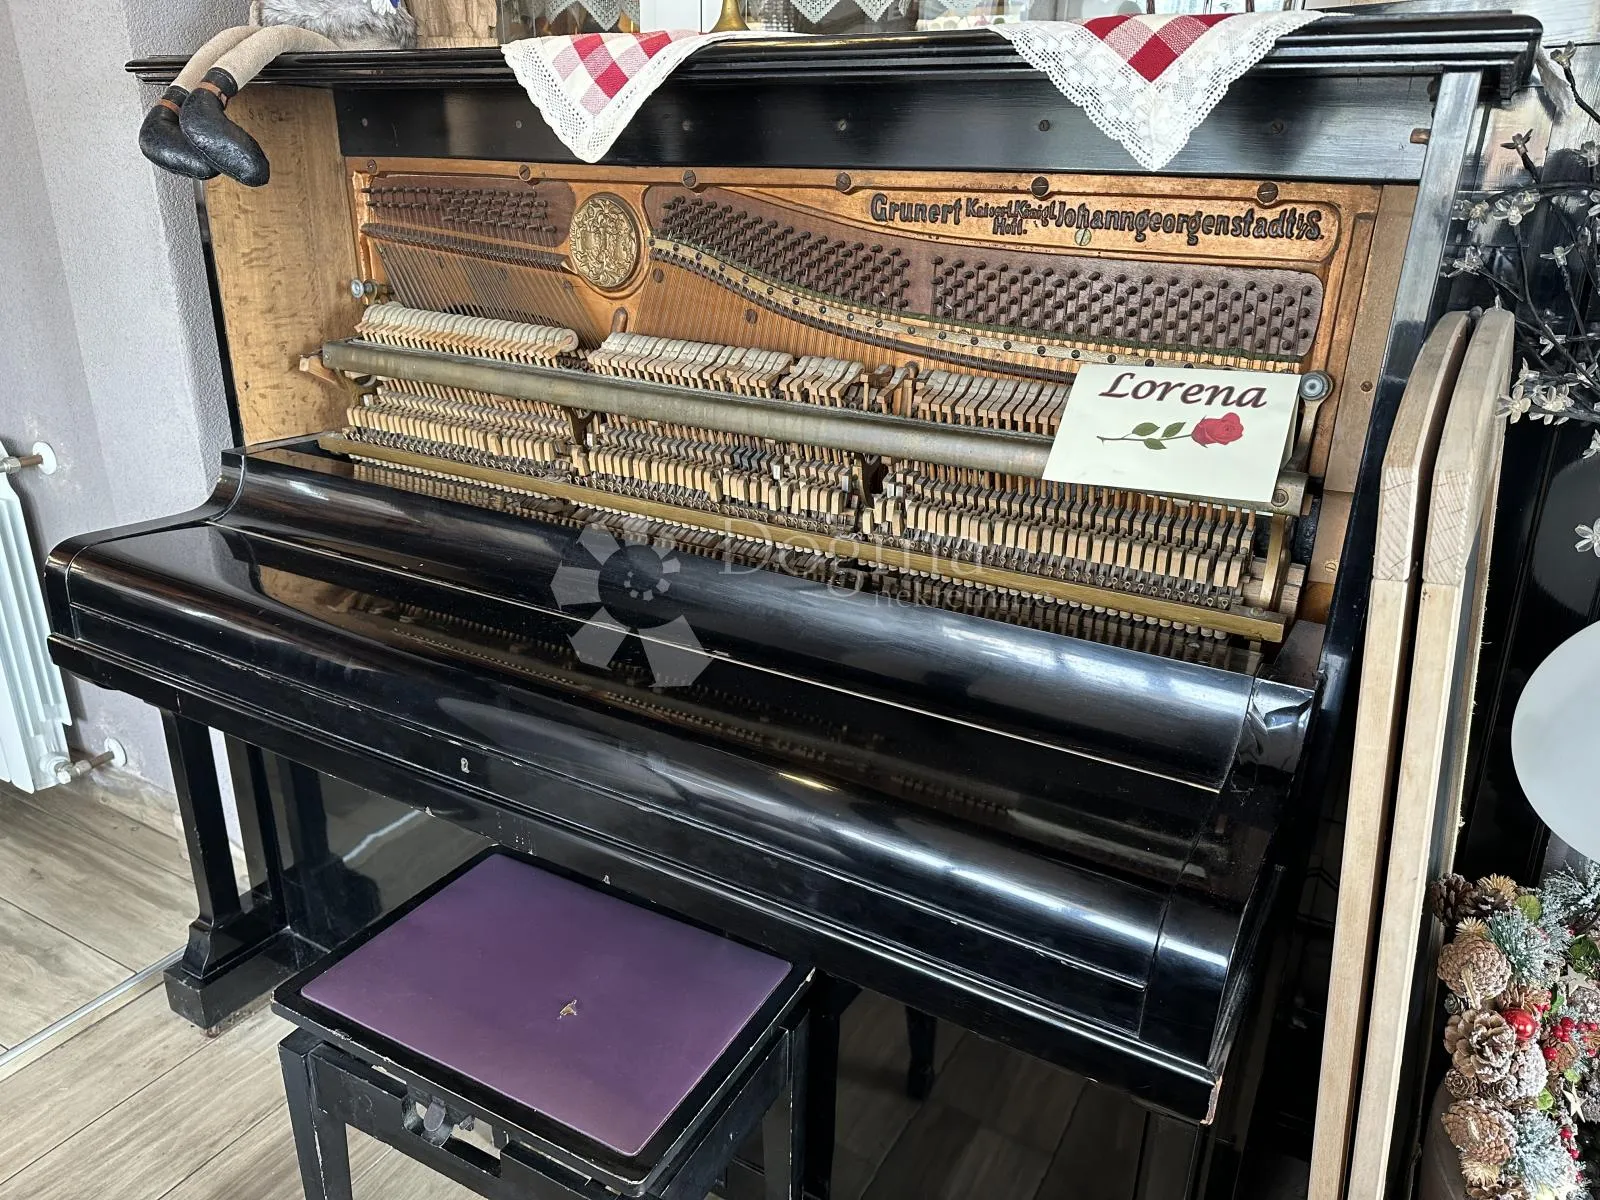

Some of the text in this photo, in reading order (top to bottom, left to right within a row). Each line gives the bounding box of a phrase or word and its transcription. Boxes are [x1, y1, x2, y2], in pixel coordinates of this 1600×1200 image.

[871, 193, 962, 225] Grunert
[1055, 201, 1296, 246] Johanngeorgenstadt
[1098, 372, 1267, 408] Lorena
